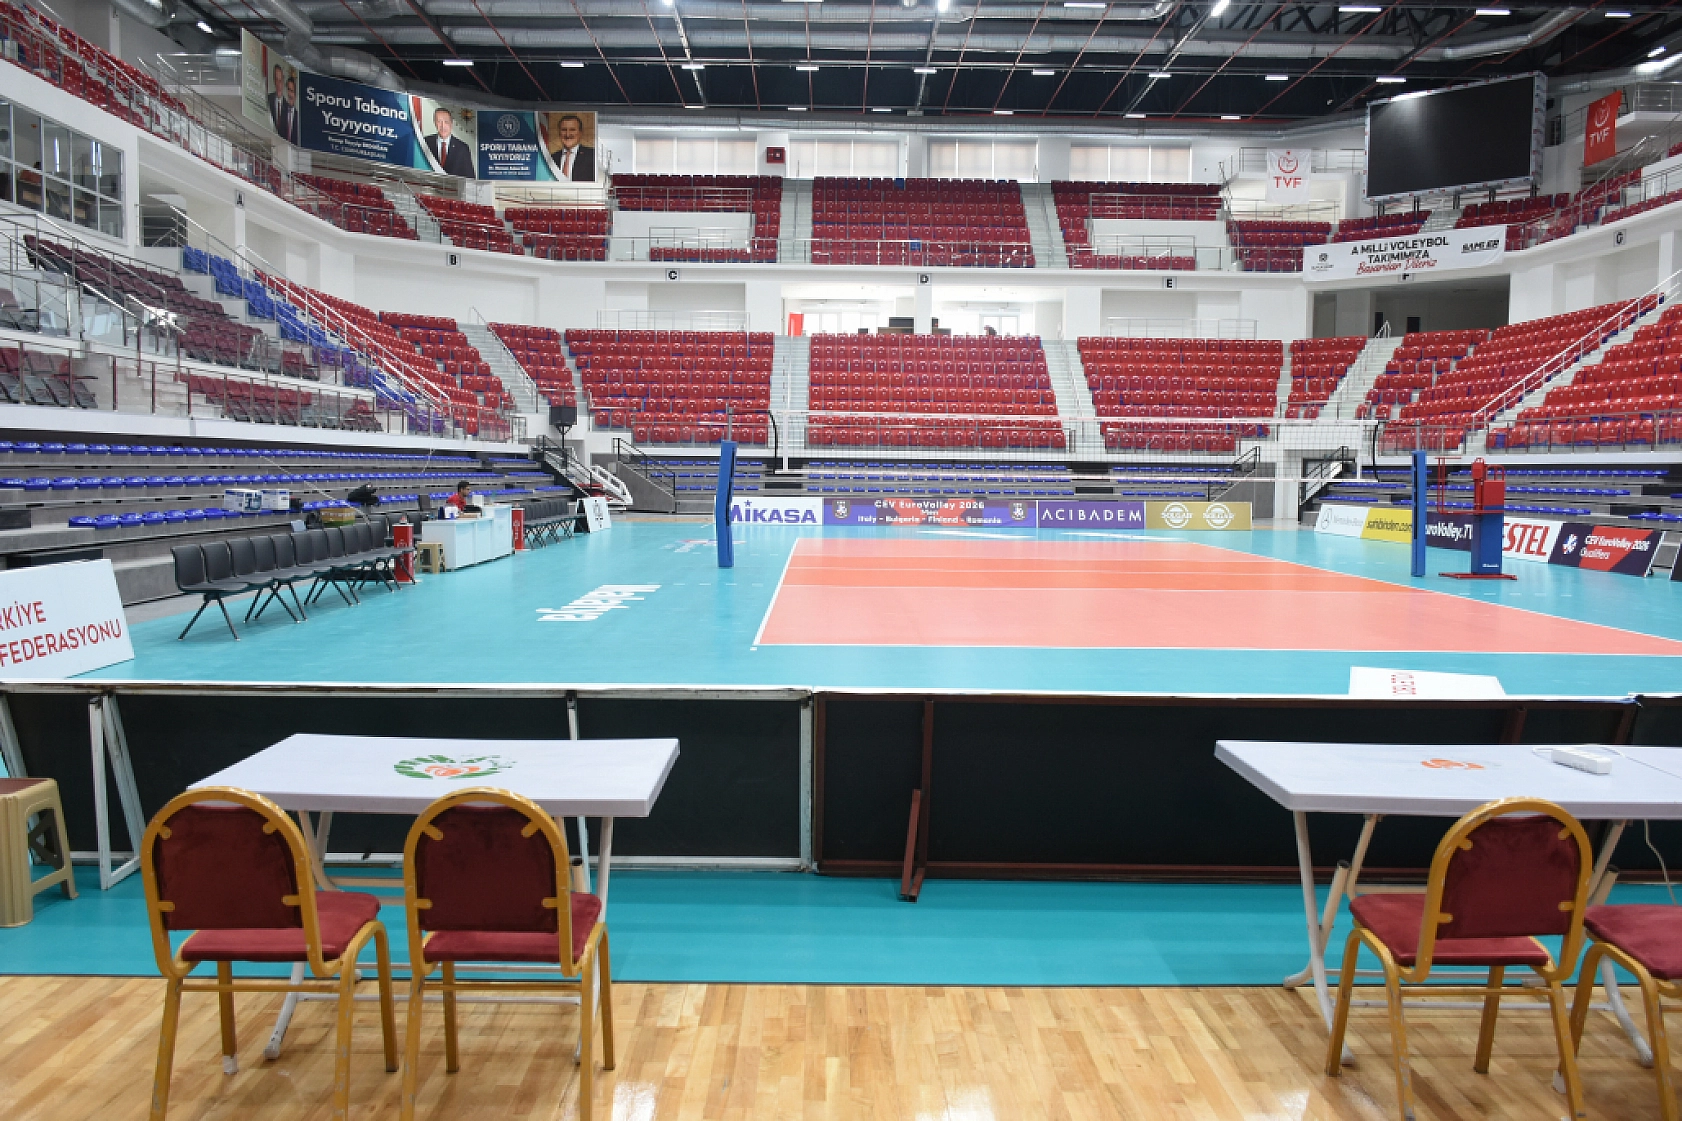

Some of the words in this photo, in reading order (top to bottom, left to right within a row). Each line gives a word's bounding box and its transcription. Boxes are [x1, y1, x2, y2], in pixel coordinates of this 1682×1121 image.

[306, 86, 351, 109] Sporu
[354, 96, 408, 121] Tabana
[1589, 127, 1611, 147] TVF
[480, 143, 506, 152] SPORU
[507, 143, 539, 152] TABANA
[1273, 176, 1302, 188] TVF
[1351, 246, 1359, 256] A
[1390, 236, 1449, 251] VOLEYBOL
[1368, 249, 1430, 264] TAKIMIMIZA
[668, 270, 678, 280] C
[920, 274, 929, 284] D
[1166, 278, 1173, 288] E
[874, 500, 896, 508] CEV
[899, 501, 956, 511] EuroVolley
[959, 501, 985, 509] 2026
[1041, 507, 1142, 522] ACIBADEM
[0, 618, 122, 667] FEDERASYONU
